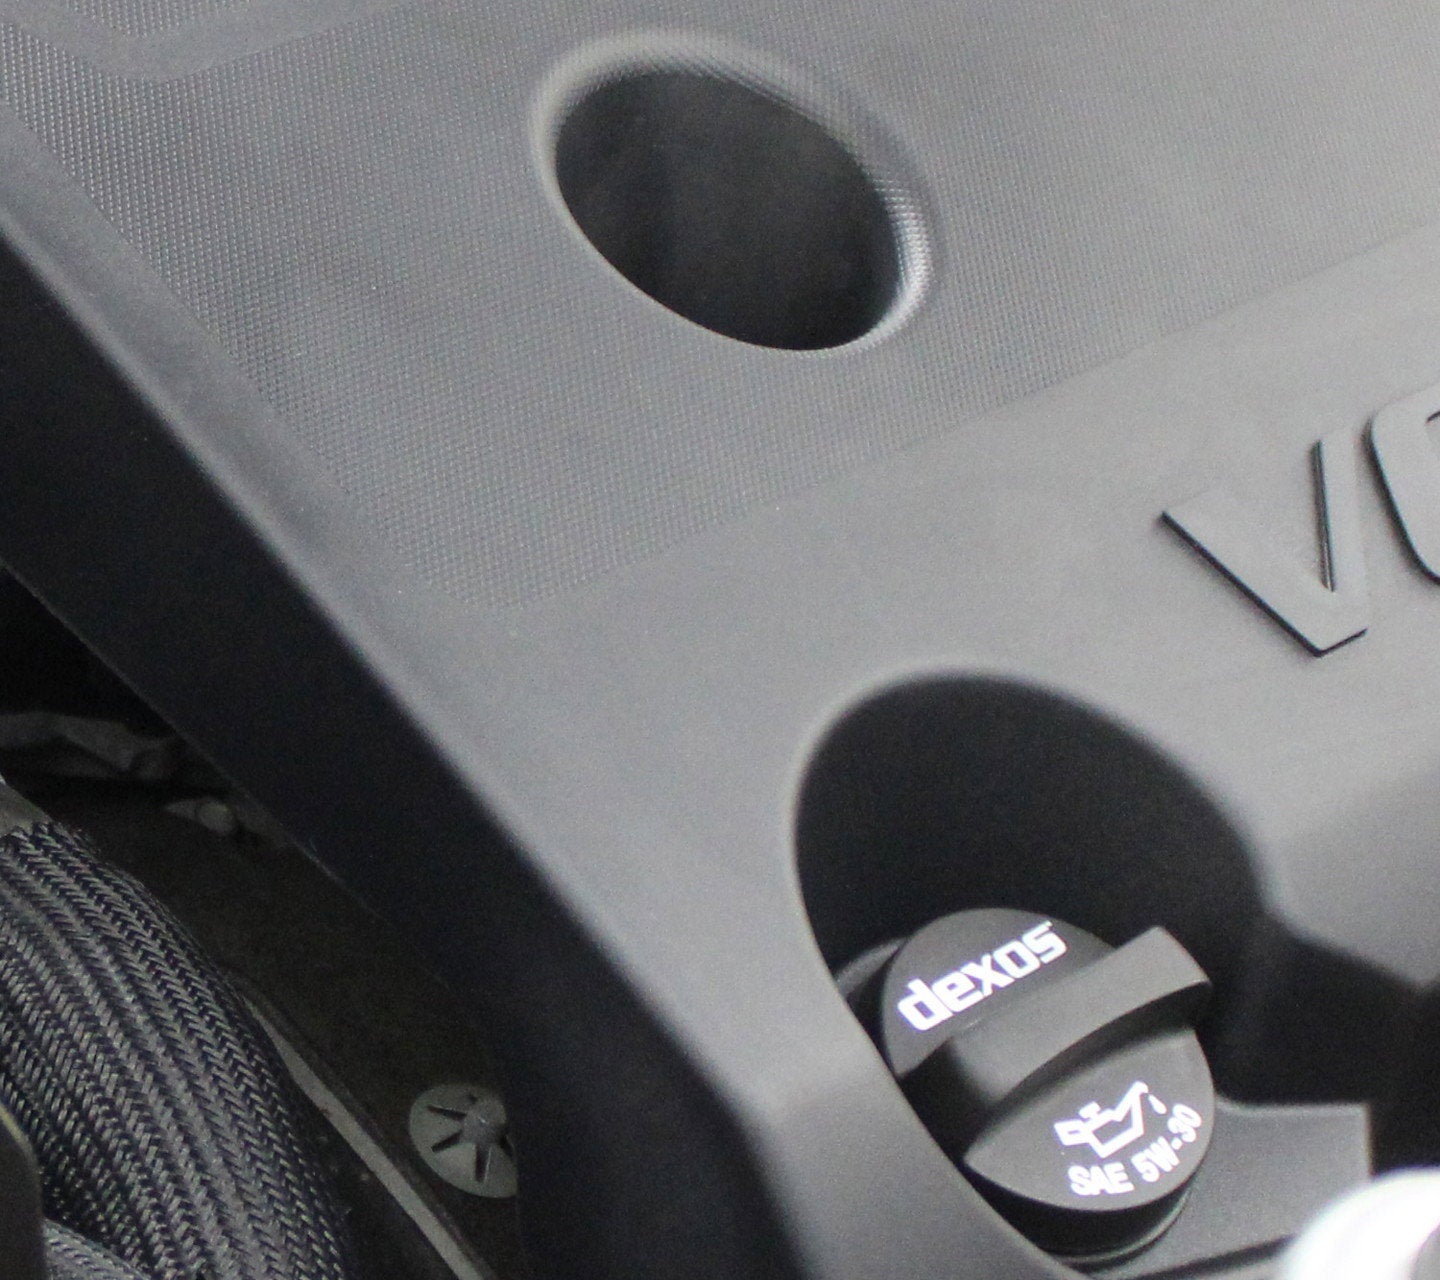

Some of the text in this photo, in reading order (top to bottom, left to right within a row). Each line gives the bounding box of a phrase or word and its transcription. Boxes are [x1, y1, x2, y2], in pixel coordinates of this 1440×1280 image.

[897, 920, 1068, 1032] dexos
[1067, 1103, 1203, 1196] SAE 5W-30
